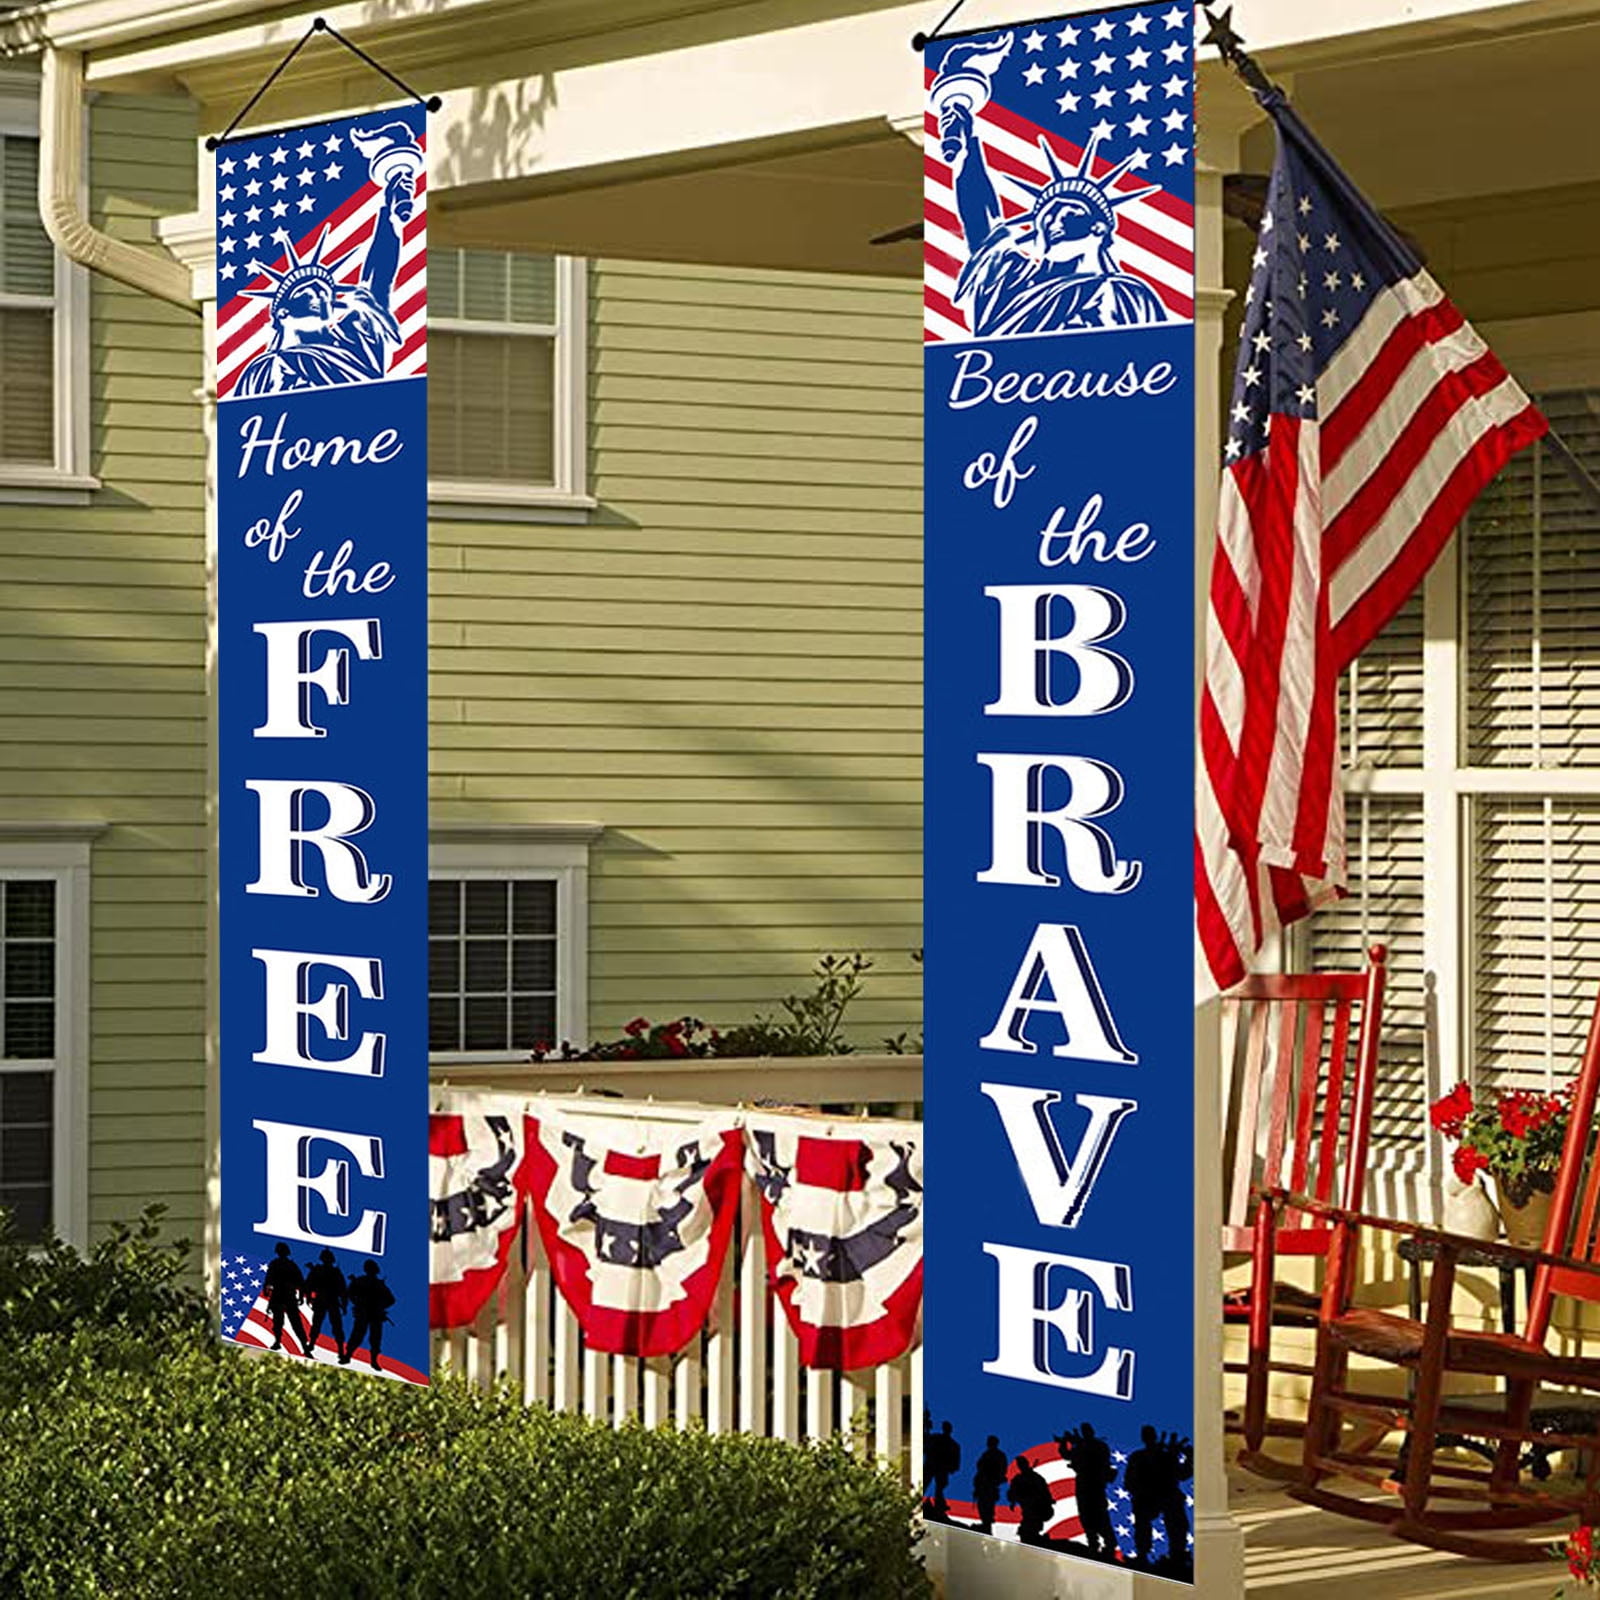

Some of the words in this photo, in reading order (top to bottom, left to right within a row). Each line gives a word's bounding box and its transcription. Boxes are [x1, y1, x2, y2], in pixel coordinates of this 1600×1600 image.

[948, 349, 1177, 409] Because
[238, 413, 403, 479] Home
[963, 416, 1038, 508] of
[245, 489, 303, 562] of
[1038, 493, 1157, 567] the
[303, 540, 396, 598] the
[245, 618, 393, 1256] FREE
[976, 584, 1143, 1401] BRAVE
